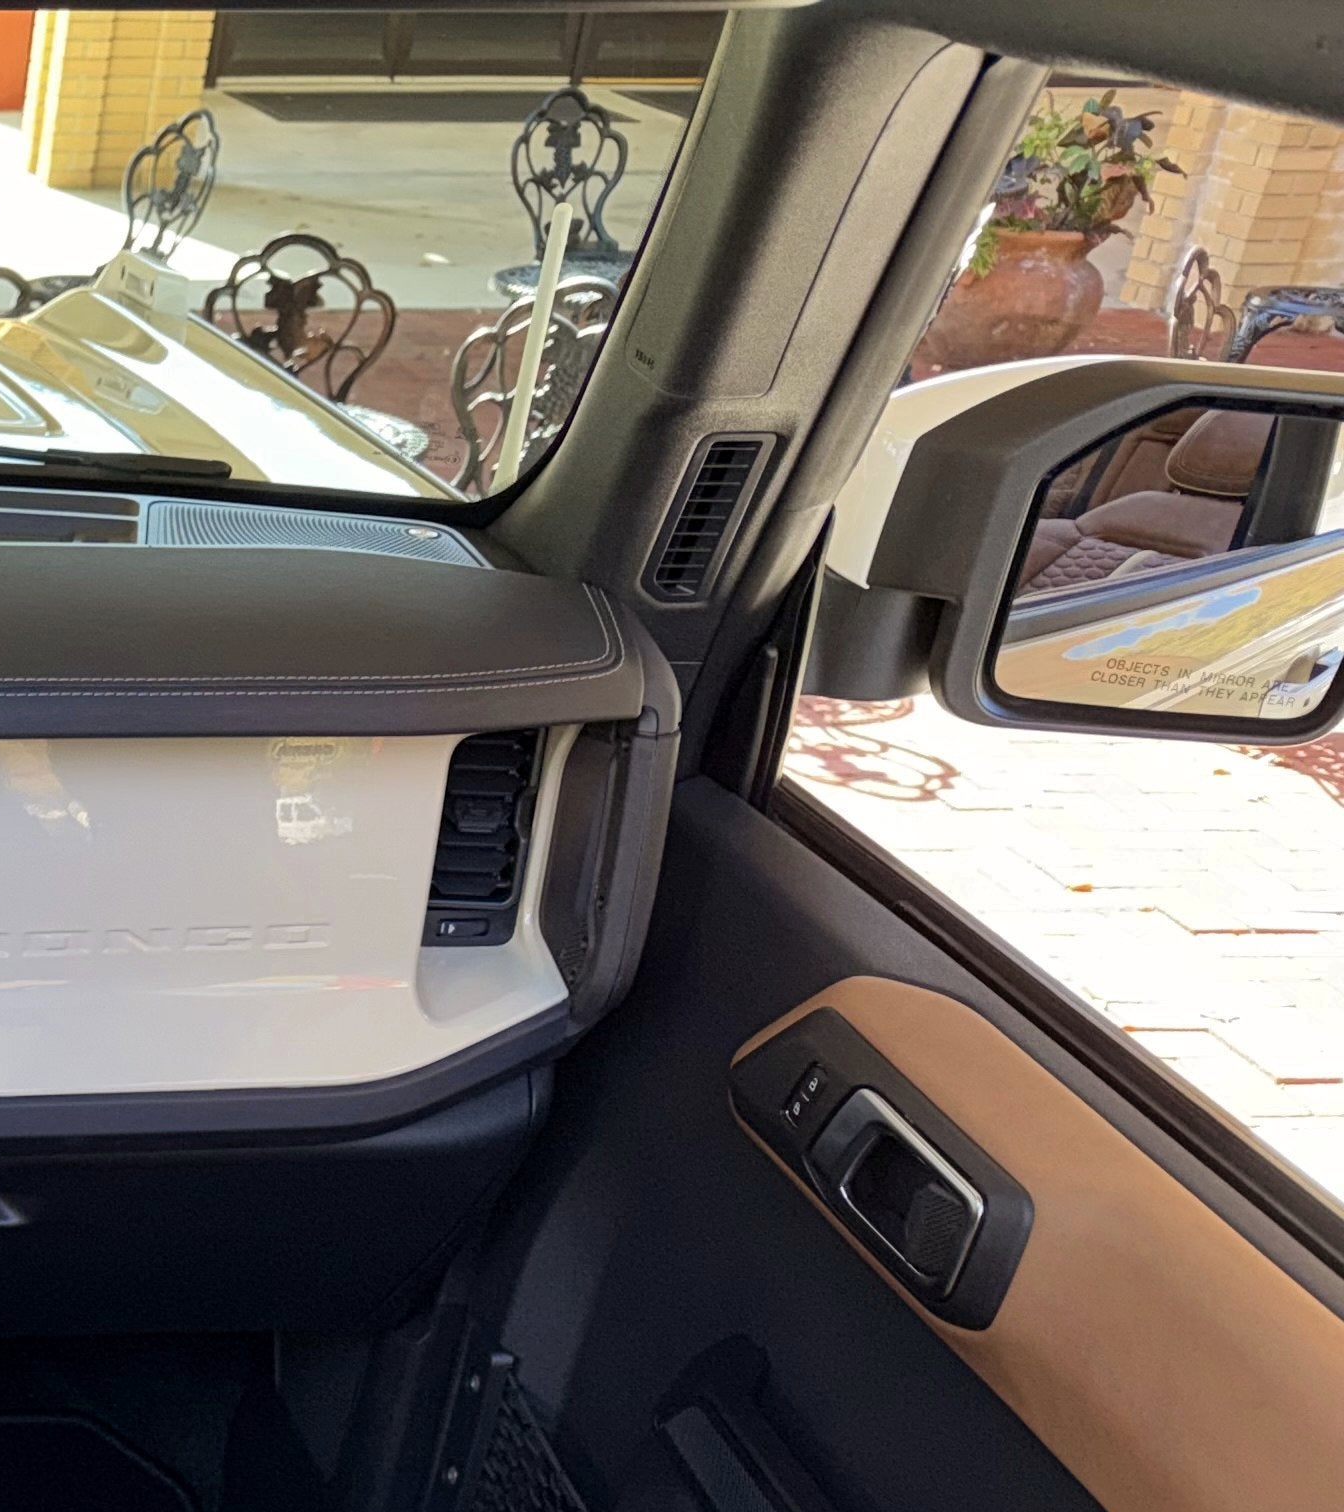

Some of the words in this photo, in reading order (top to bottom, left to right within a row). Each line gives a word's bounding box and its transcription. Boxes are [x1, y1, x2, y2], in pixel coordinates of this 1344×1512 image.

[1090, 670, 1146, 688] CLOSER
[1153, 678, 1193, 694] THAN
[1197, 686, 1235, 700] THEY
[1238, 691, 1297, 708] APPEAR
[1106, 657, 1171, 677] OBJECTS
[1177, 667, 1192, 679] IN
[1199, 671, 1256, 688] MIRROR
